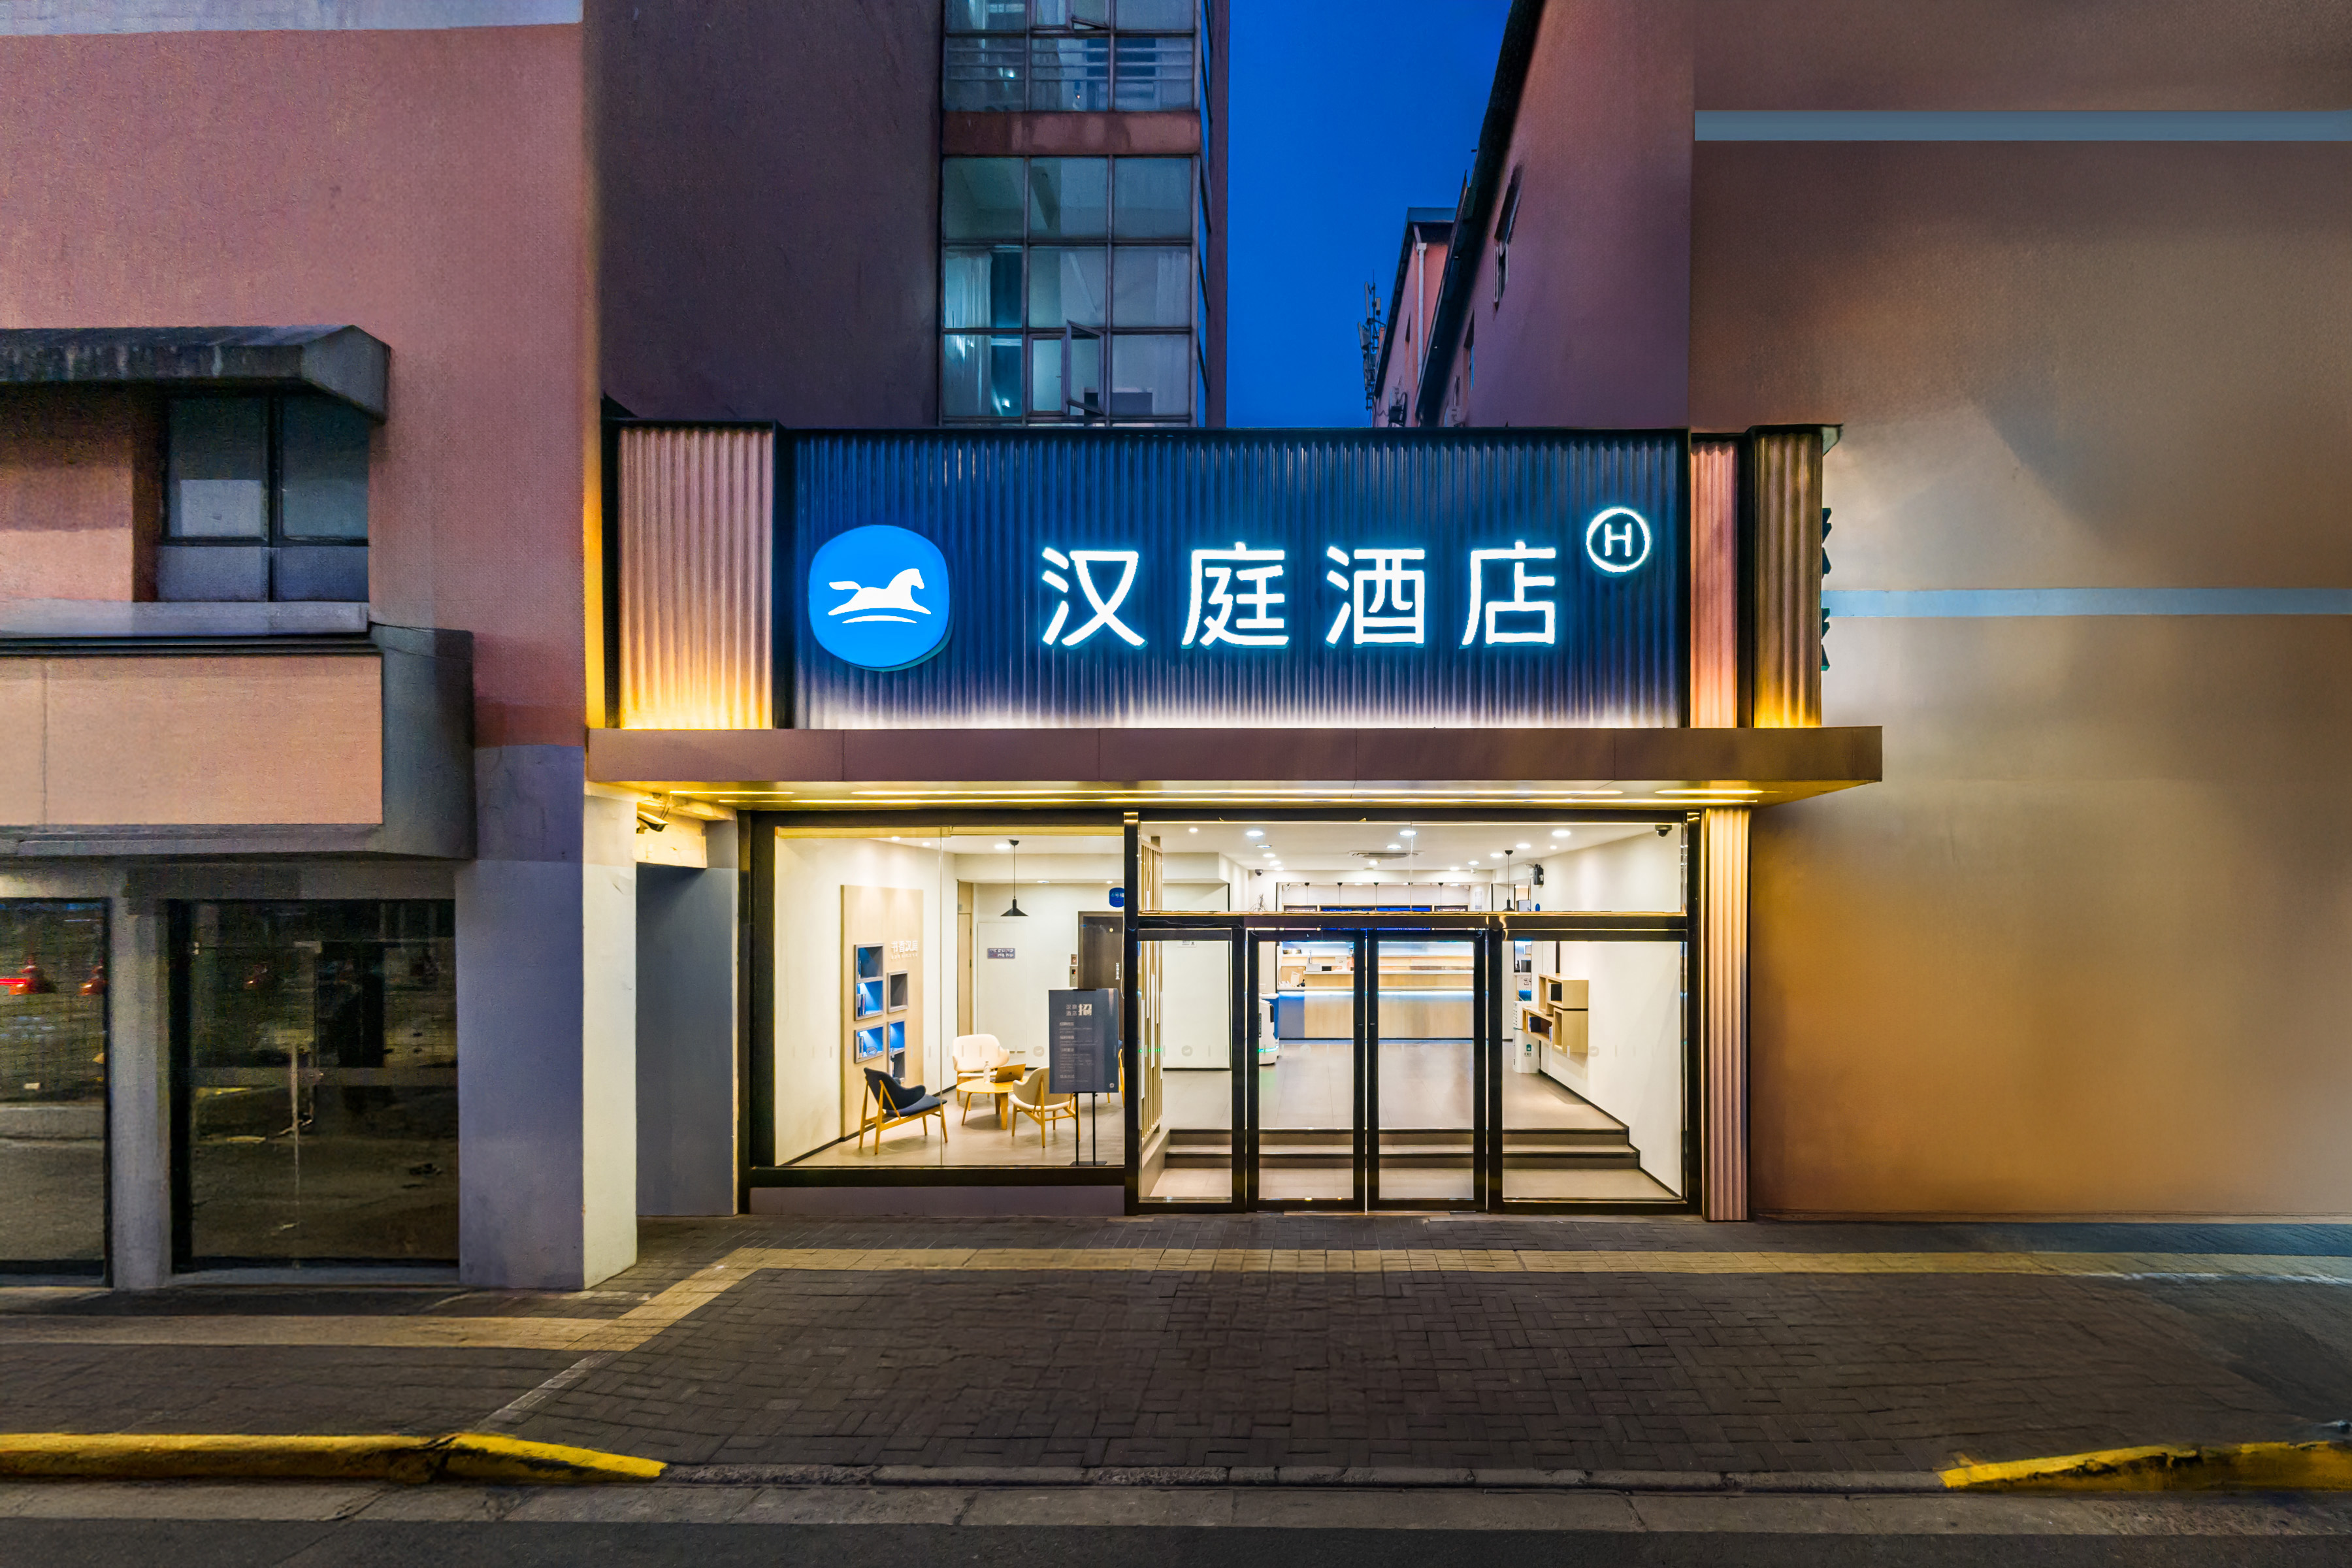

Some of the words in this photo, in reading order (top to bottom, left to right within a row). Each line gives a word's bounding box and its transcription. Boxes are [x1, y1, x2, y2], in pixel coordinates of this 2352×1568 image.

[1041, 540, 1557, 647] 汉庭酒店
[890, 940, 919, 953] 书香汉庭
